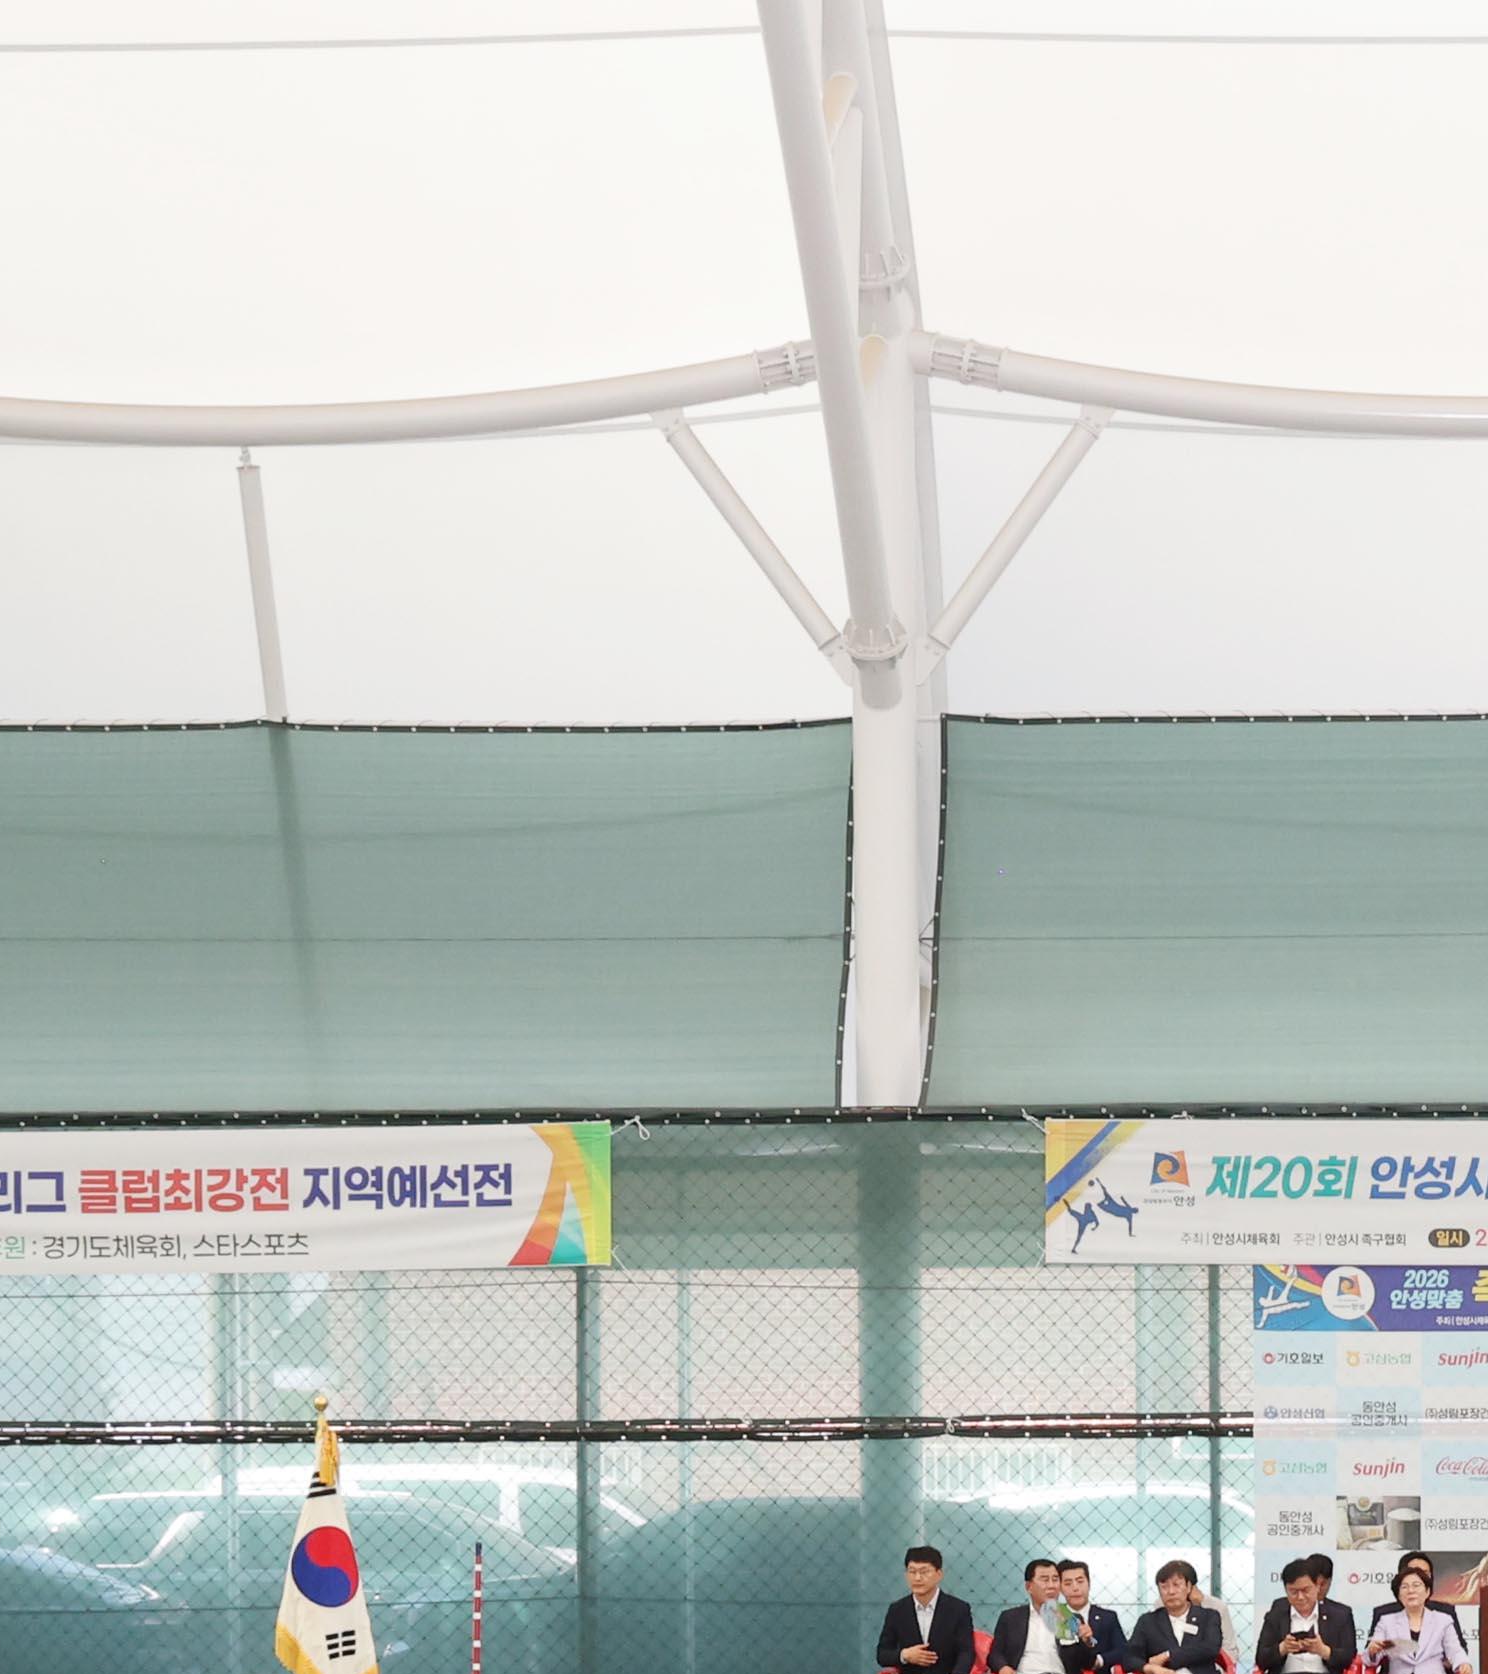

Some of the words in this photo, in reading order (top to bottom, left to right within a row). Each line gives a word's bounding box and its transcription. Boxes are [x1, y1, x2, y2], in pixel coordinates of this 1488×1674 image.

[1205, 1155, 1359, 1200] 제20회
[78, 1168, 289, 1214] 클럽최강전
[302, 1163, 513, 1211] 지역예선전
[43, 1234, 187, 1262] 경기도체육회,
[193, 1233, 309, 1258] 스타스포츠
[1180, 1232, 1205, 1246] 주최
[1211, 1231, 1280, 1247] 안성시체육회
[1292, 1232, 1318, 1246] 주관
[1324, 1231, 1359, 1247] 안성시
[1361, 1231, 1407, 1247] 족구협회
[1435, 1230, 1465, 1248] 일시
[1403, 1269, 1450, 1289] 2026
[1389, 1289, 1464, 1310] 안성맞춤
[1277, 1352, 1325, 1365] 기호일보
[1362, 1401, 1397, 1414] 동안성
[1353, 1457, 1406, 1479] Sunjin
[1279, 1510, 1313, 1524] 동안성
[1267, 1523, 1325, 1537] 공인중개사
